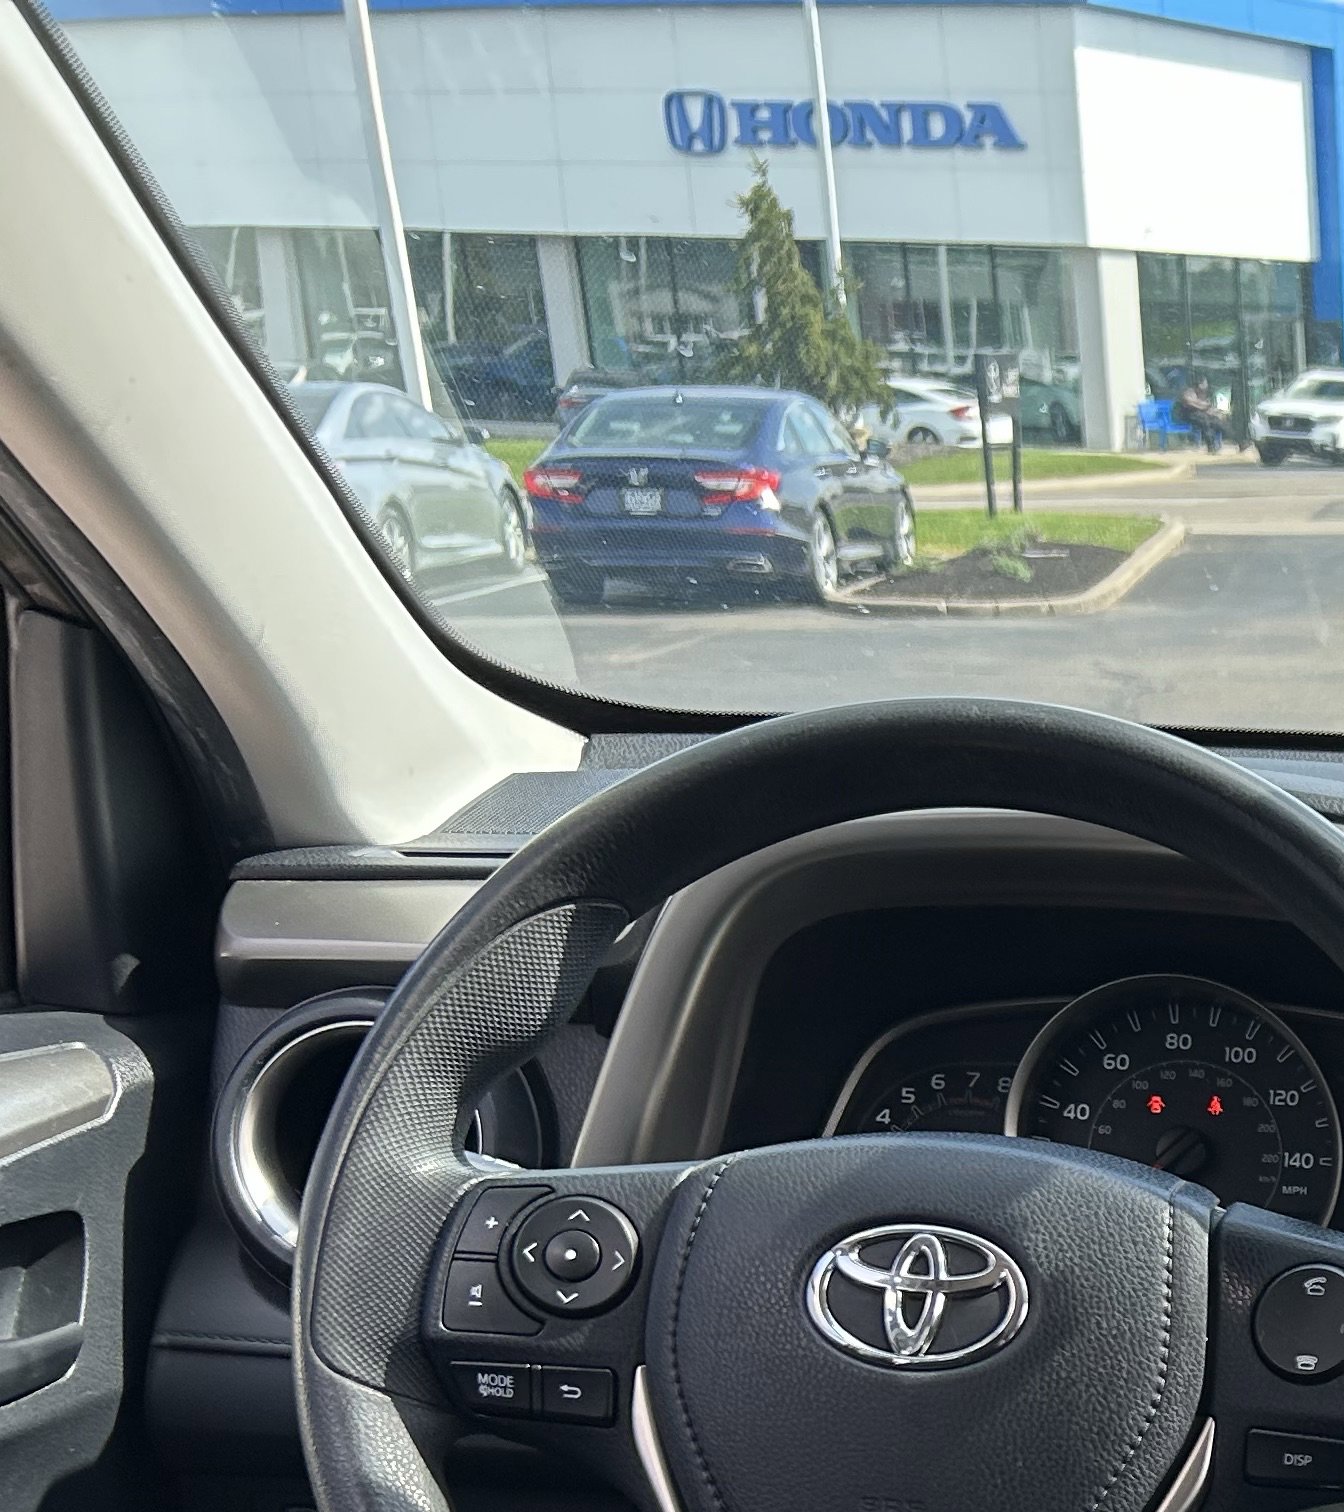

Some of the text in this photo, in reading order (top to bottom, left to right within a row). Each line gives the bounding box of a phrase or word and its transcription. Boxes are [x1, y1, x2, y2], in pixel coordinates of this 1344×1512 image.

[730, 98, 1028, 151] HONDA
[1165, 1033, 1192, 1050] 80
[1103, 1053, 1130, 1070] 60
[1224, 1046, 1257, 1064] 100
[930, 1073, 946, 1090] 6
[966, 1071, 981, 1088] 7
[1160, 1069, 1176, 1081] 120
[997, 1077, 1012, 1093] 8
[1131, 1079, 1149, 1091] 100
[901, 1087, 916, 1104] 5
[1268, 1089, 1300, 1107] 120
[875, 1108, 891, 1125] 4
[1063, 1103, 1090, 1121] 40
[1098, 1125, 1112, 1136] 60
[1283, 1152, 1314, 1169] 140
[1282, 1185, 1308, 1195] MPH
[477, 1372, 515, 1387] MODE
[1284, 1453, 1313, 1467] DISP
